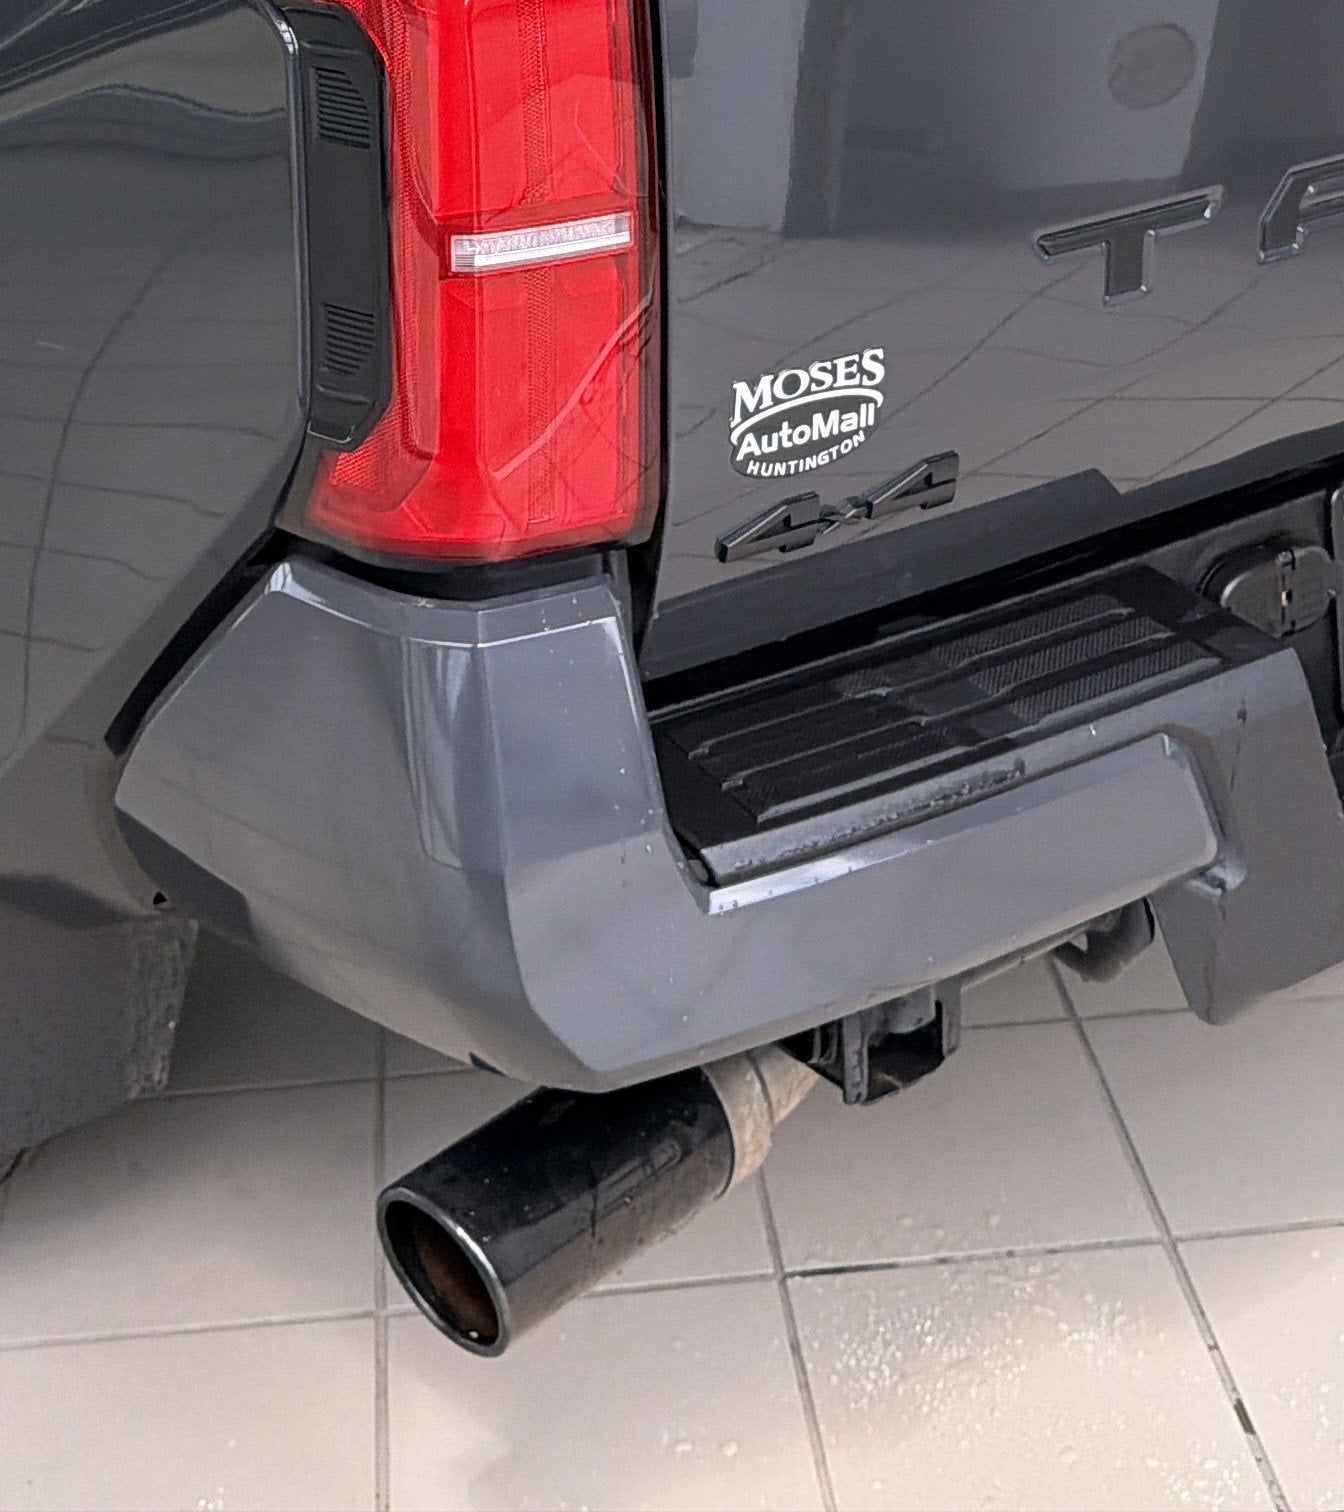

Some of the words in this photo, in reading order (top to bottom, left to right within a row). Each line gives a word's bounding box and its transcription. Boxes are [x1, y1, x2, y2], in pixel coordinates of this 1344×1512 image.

[730, 347, 886, 428] MOSES
[736, 402, 876, 461] AutoMall
[746, 430, 866, 477] HUNTINGTON
